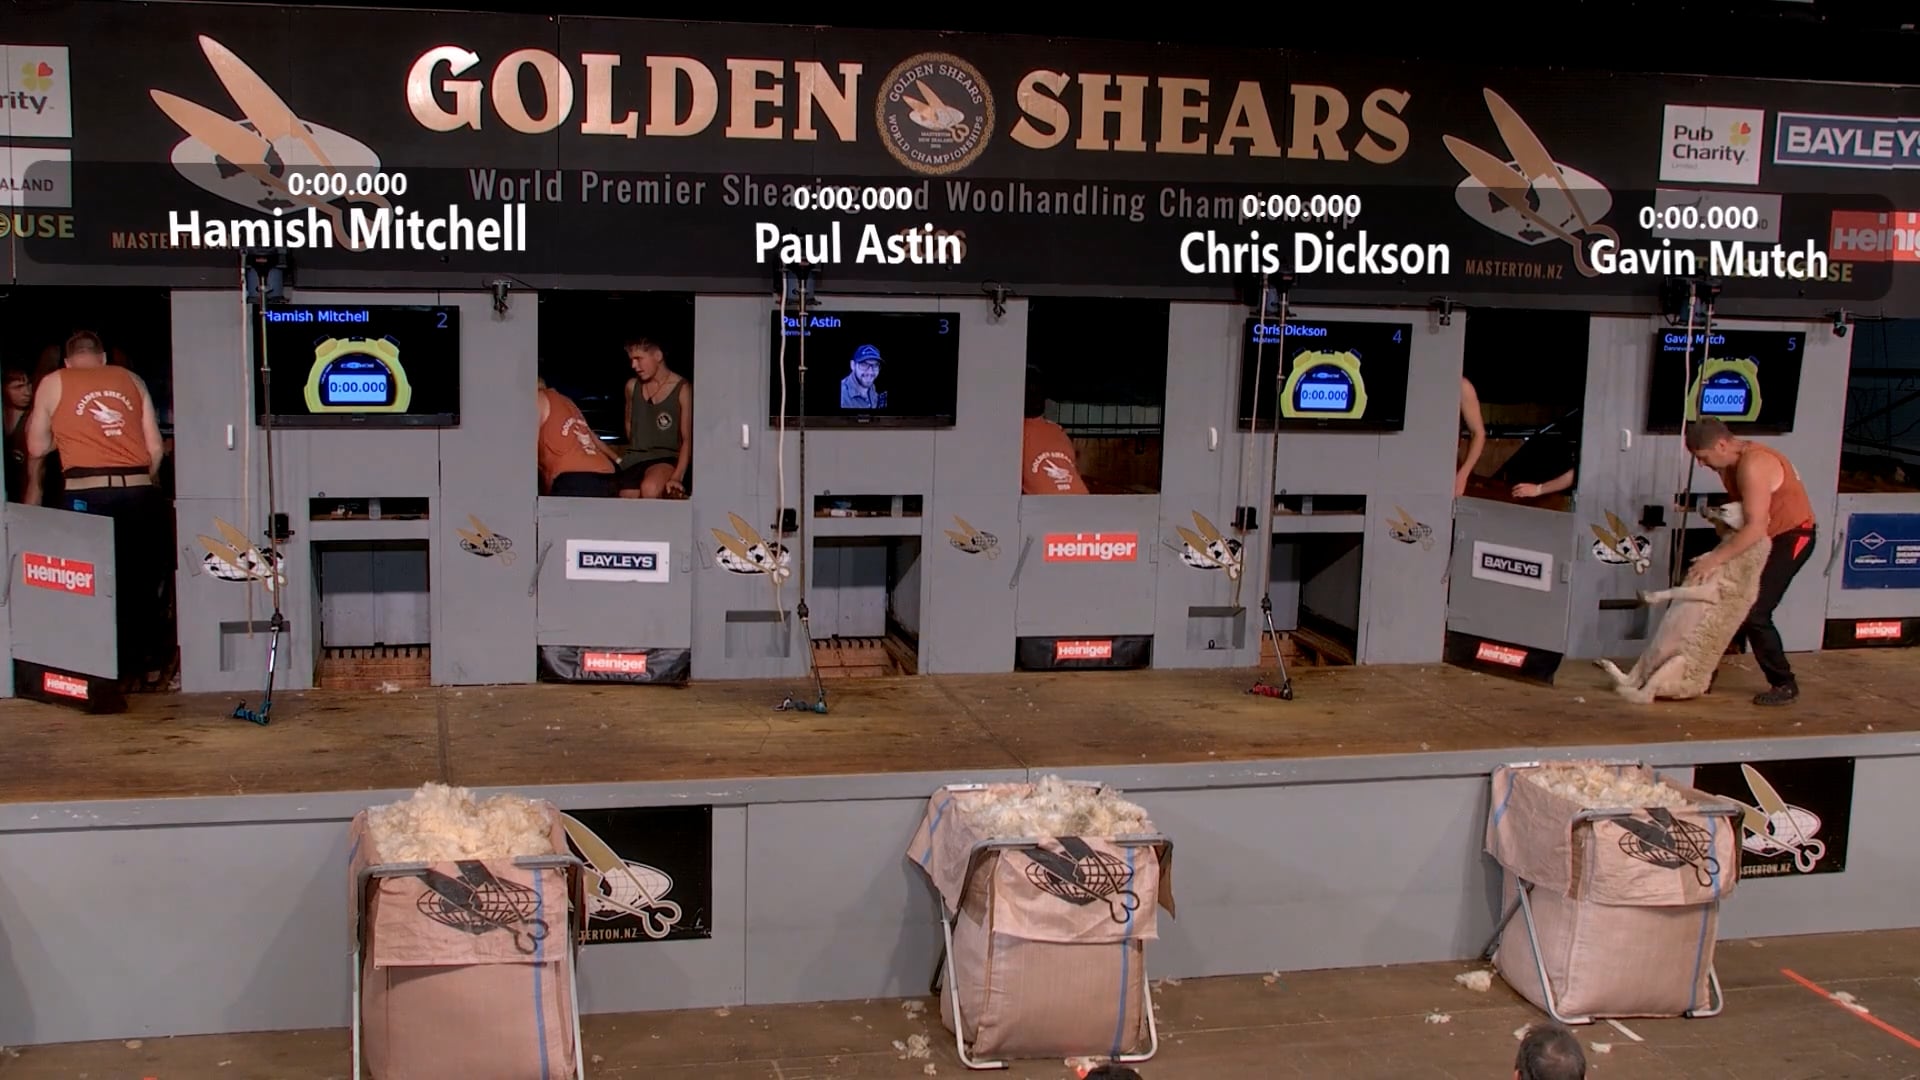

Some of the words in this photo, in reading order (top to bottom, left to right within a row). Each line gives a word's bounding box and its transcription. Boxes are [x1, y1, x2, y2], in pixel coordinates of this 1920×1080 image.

[889, 64, 934, 102] GOLDEN
[938, 64, 983, 104] SHEARS
[407, 45, 863, 142] GOLDEN
[1009, 69, 1412, 165] SHEARS
[888, 114, 910, 152] WORLD
[910, 115, 984, 164] CHAMPIONSHIPS
[1674, 124, 1713, 142] Pub
[1787, 125, 1920, 158] BAYLEY
[1672, 143, 1745, 165] Charity
[470, 168, 562, 202] World
[581, 170, 705, 206] Premier
[946, 180, 1145, 222] Woolhandling
[1465, 259, 1563, 279] MASTERTON.NZ
[266, 310, 313, 322] Hamish
[318, 310, 369, 322] Mitchell
[437, 312, 448, 328] 2
[810, 315, 841, 328] Astin
[938, 319, 949, 334] 3
[1253, 323, 1280, 335] Chris
[1285, 324, 1328, 337] Dickson
[1392, 329, 1403, 344] 4
[1695, 334, 1726, 345] Mtch
[1787, 337, 1797, 351] 5
[330, 382, 387, 393] 0:00.000
[1302, 390, 1348, 401] 0:00.000
[1704, 394, 1745, 405] 0:00.000
[1048, 533, 1136, 560] Heiniger
[582, 554, 653, 568] BAYLEYS
[1484, 556, 1540, 576] BAYLEYS
[26, 556, 93, 590] Heiniger
[1856, 622, 1898, 637] Heiniger
[1058, 641, 1111, 657] Heiniger
[586, 652, 645, 671] Heiniger
